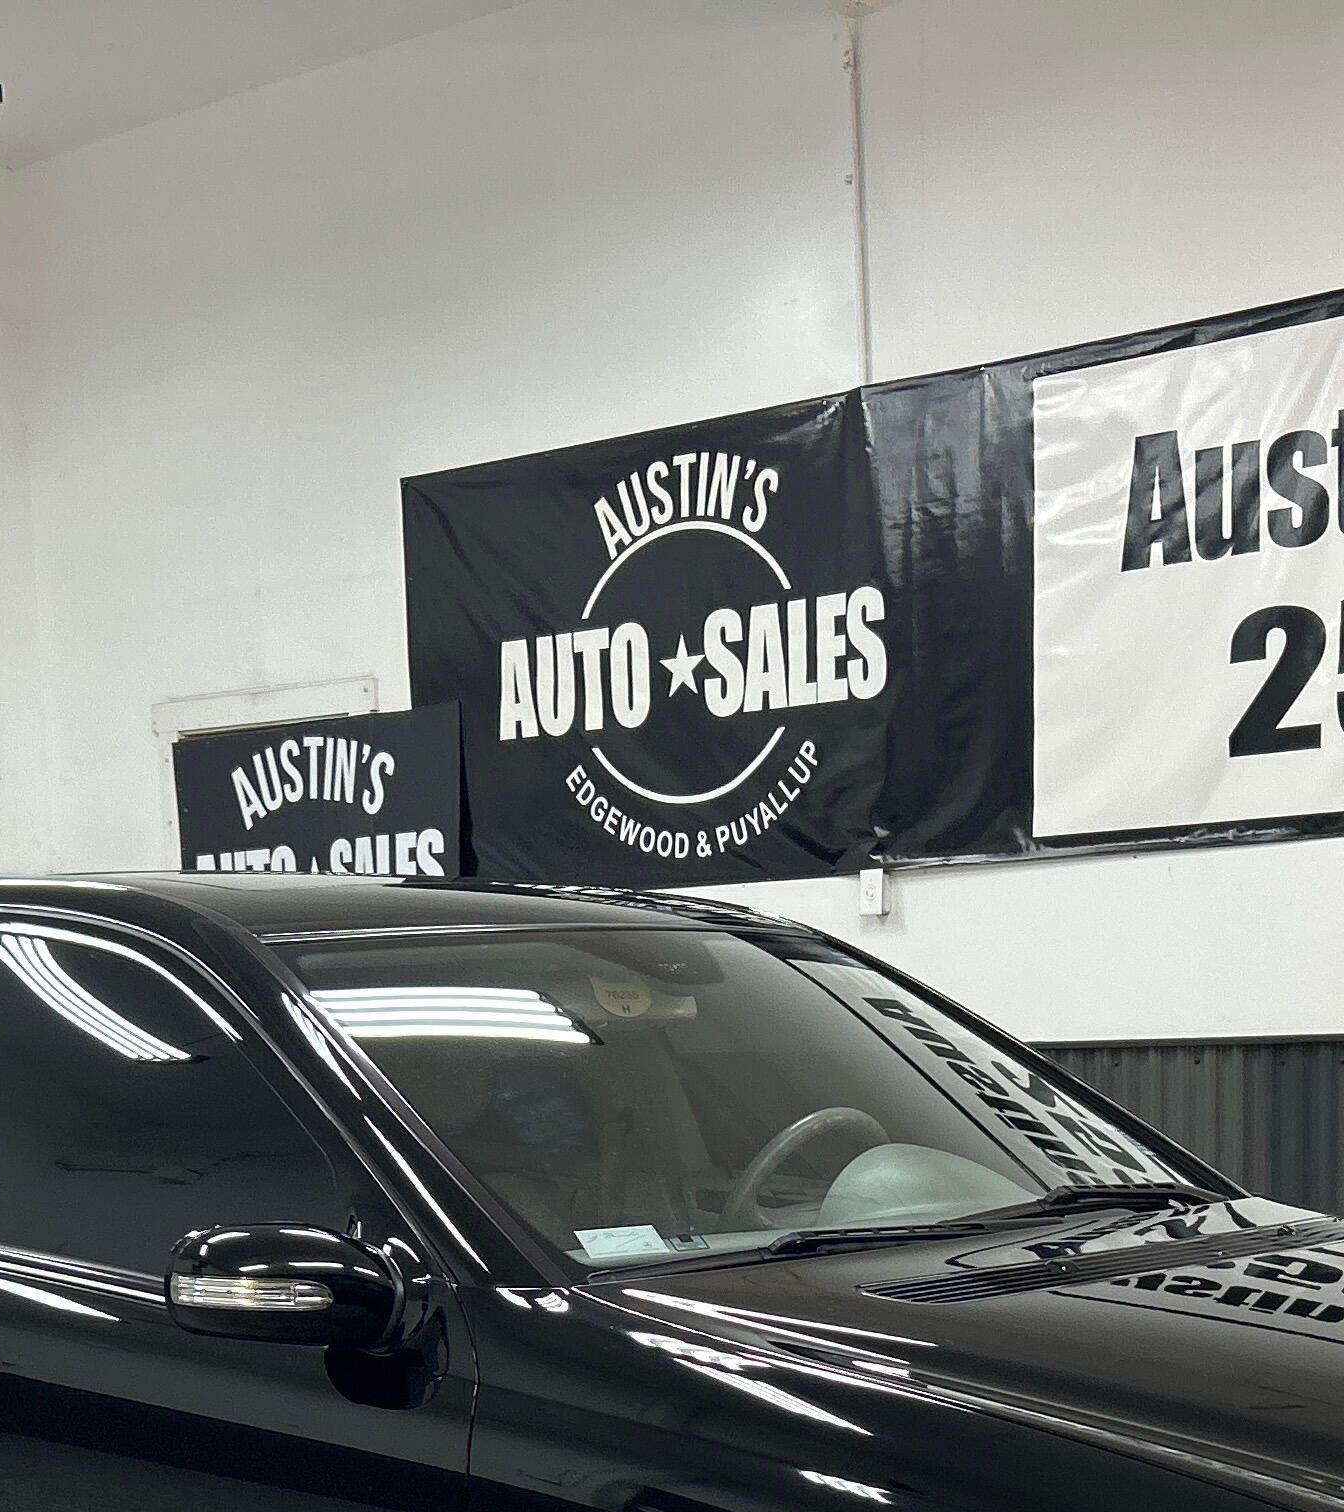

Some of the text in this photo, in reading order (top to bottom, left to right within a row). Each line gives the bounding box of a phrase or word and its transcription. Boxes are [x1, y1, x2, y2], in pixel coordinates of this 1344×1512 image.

[594, 452, 778, 560] AUSTIN'S
[500, 586, 887, 740] AUTO SALES
[232, 737, 395, 830] AUSTIN'S
[566, 740, 818, 858] EDGEWOOD & PUYALLUP
